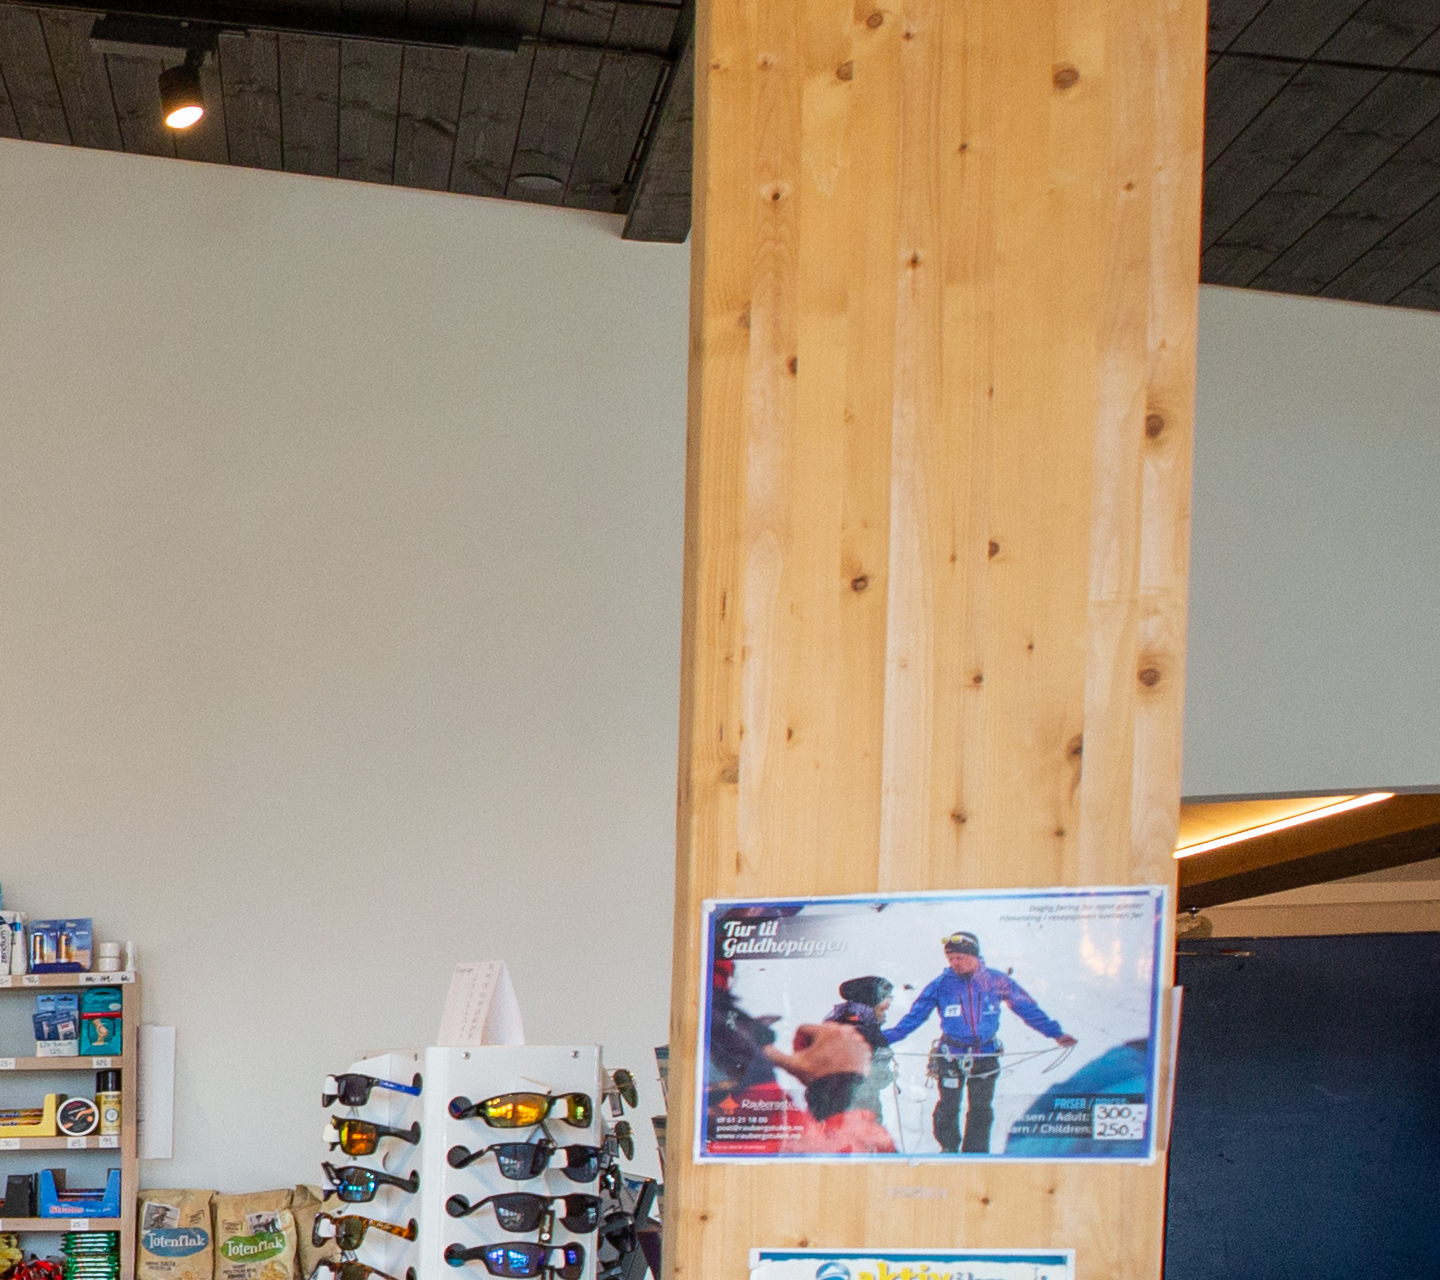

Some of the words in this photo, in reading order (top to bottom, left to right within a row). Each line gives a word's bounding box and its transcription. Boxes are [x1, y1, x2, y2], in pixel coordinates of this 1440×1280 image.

[723, 920, 756, 938] Tur
[758, 920, 779, 937] til
[1054, 1098, 1087, 1110] PRISER
[147, 1232, 207, 1249] Totenflak
[226, 1236, 284, 1256] Totenflak
